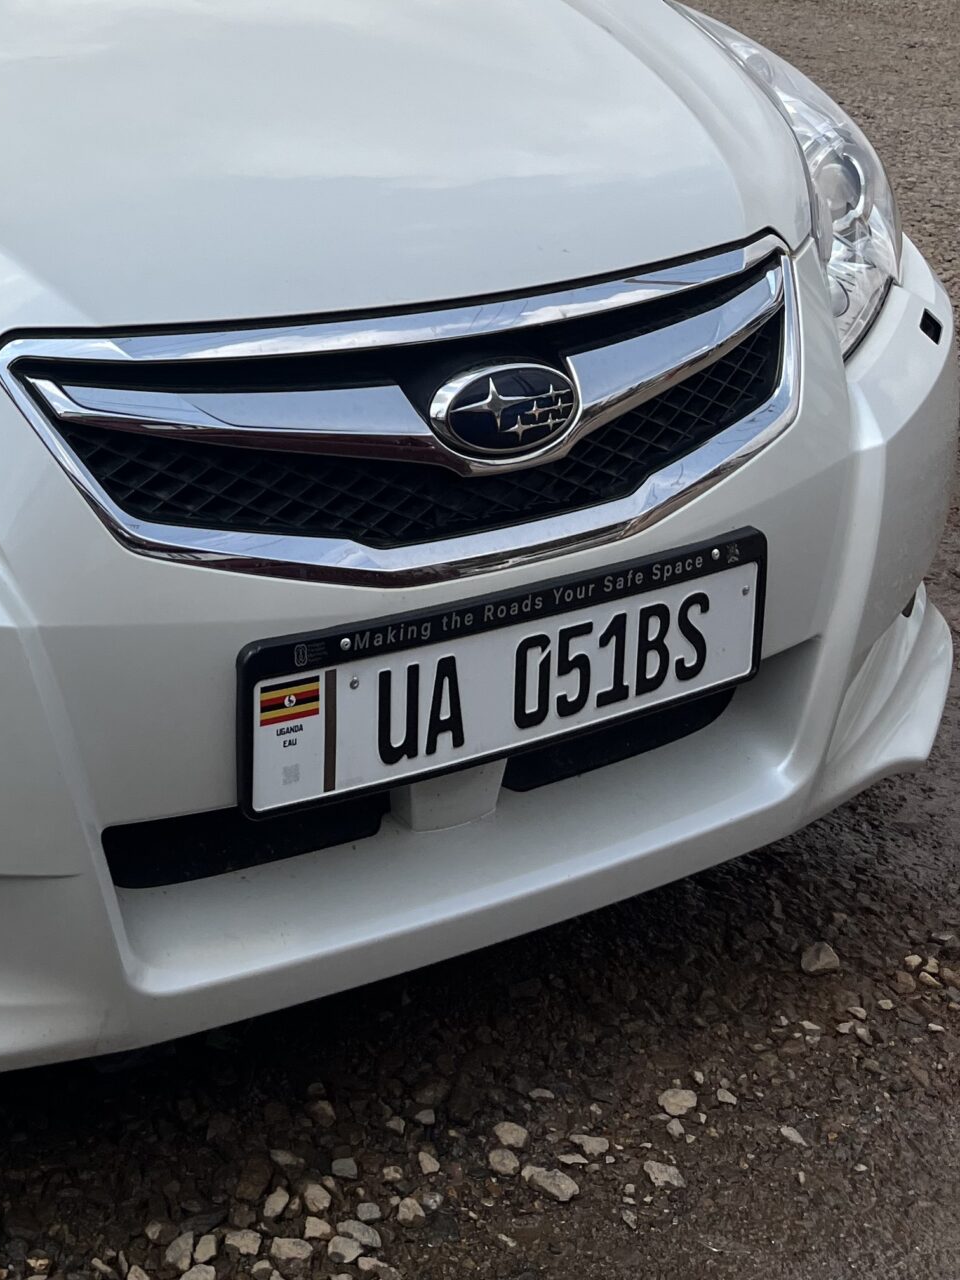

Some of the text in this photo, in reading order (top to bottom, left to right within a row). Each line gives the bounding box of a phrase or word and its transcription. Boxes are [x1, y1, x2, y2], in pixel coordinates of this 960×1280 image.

[353, 556, 704, 651] Making the Roads Your Safe Space
[377, 591, 710, 765] UA 051BS
[276, 723, 304, 737] UGANDA
[283, 738, 297, 748] EAU
